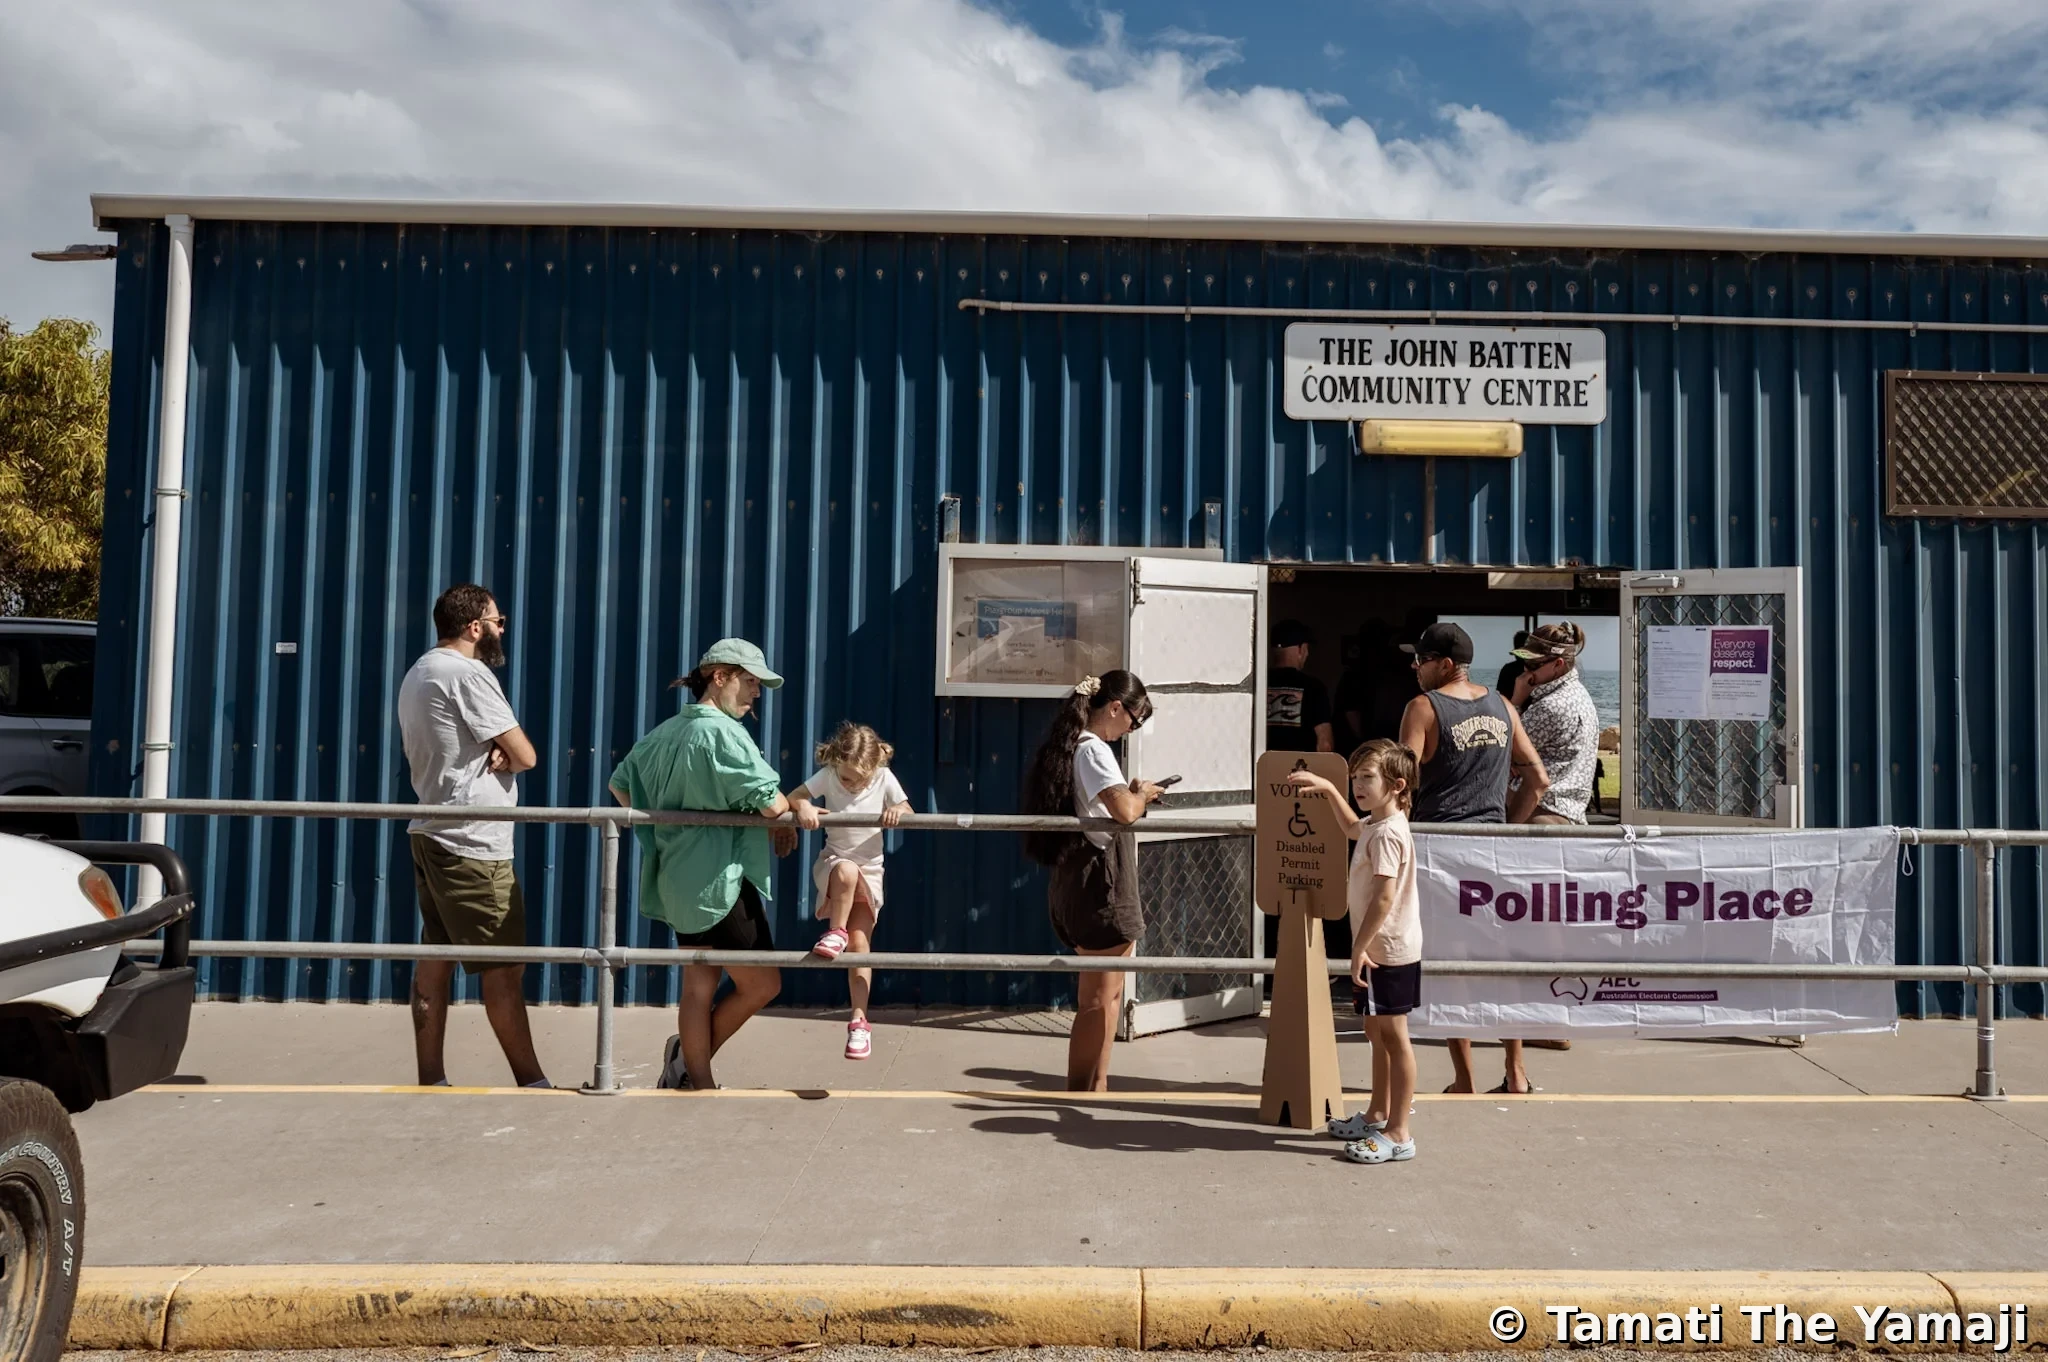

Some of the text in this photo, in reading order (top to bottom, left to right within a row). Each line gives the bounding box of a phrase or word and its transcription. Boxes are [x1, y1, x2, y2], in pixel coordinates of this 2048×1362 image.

[1319, 337, 1573, 370] THE JOHN BATTEN
[1301, 374, 1589, 407] COMMUNITY CENTRE
[1713, 639, 1756, 650] Everyone
[1713, 649, 1755, 659] deserves
[1713, 659, 1756, 669] respect.
[1276, 840, 1325, 854] Disabled
[1281, 856, 1320, 870] Permit
[1278, 873, 1324, 889] Parking
[1458, 879, 1814, 930] Polling Place
[1598, 976, 1641, 988] AEC
[1601, 992, 1715, 1000] Australian Electoral Commission
[19, 1141, 73, 1205] COUNTRY
